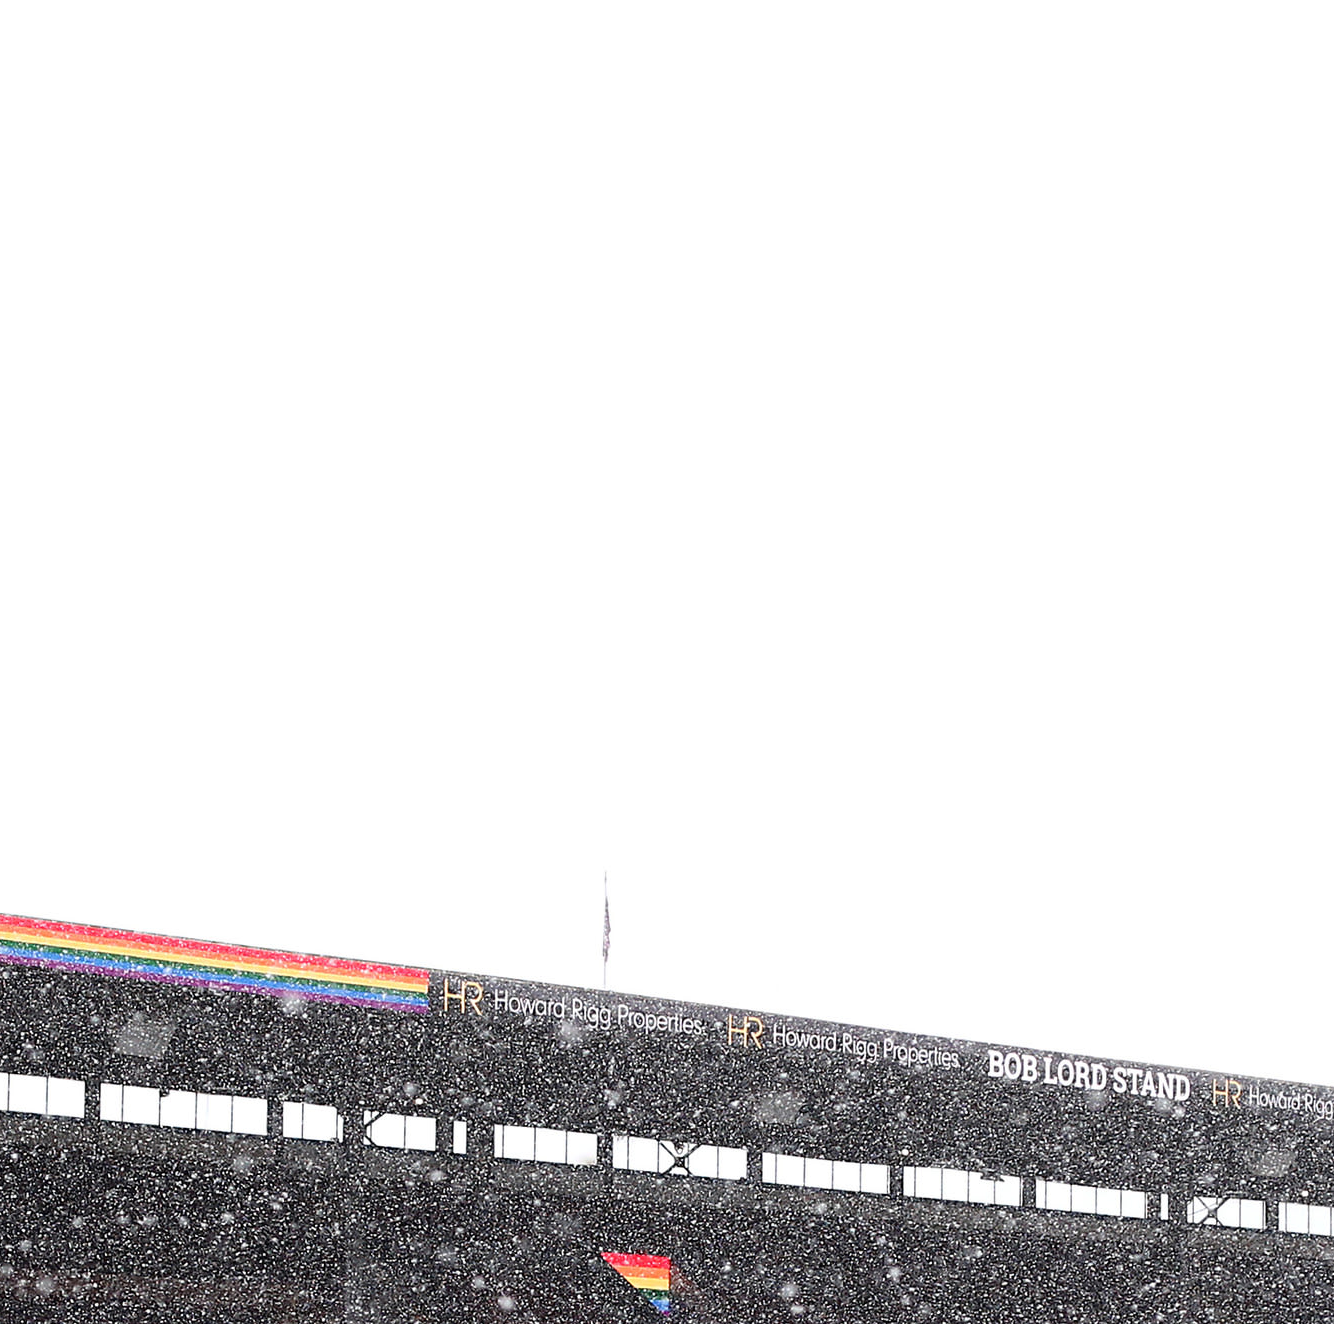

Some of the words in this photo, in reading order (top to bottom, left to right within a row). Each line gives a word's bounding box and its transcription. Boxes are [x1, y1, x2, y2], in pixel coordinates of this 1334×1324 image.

[443, 978, 484, 1015] HR
[494, 989, 567, 1019] Howard
[572, 998, 611, 1030] Rigg
[618, 1004, 703, 1035] Properties
[727, 1014, 765, 1049] HR
[772, 1024, 837, 1052] Howard
[842, 1032, 878, 1063] Rigg
[883, 1038, 960, 1068] Properties
[987, 1050, 1038, 1082] BOB
[1043, 1056, 1107, 1091] LORD
[1113, 1066, 1191, 1102] STAND
[1212, 1078, 1243, 1110] HR
[1248, 1085, 1301, 1111] Howard
[1304, 1093, 1334, 1121] Rigg
